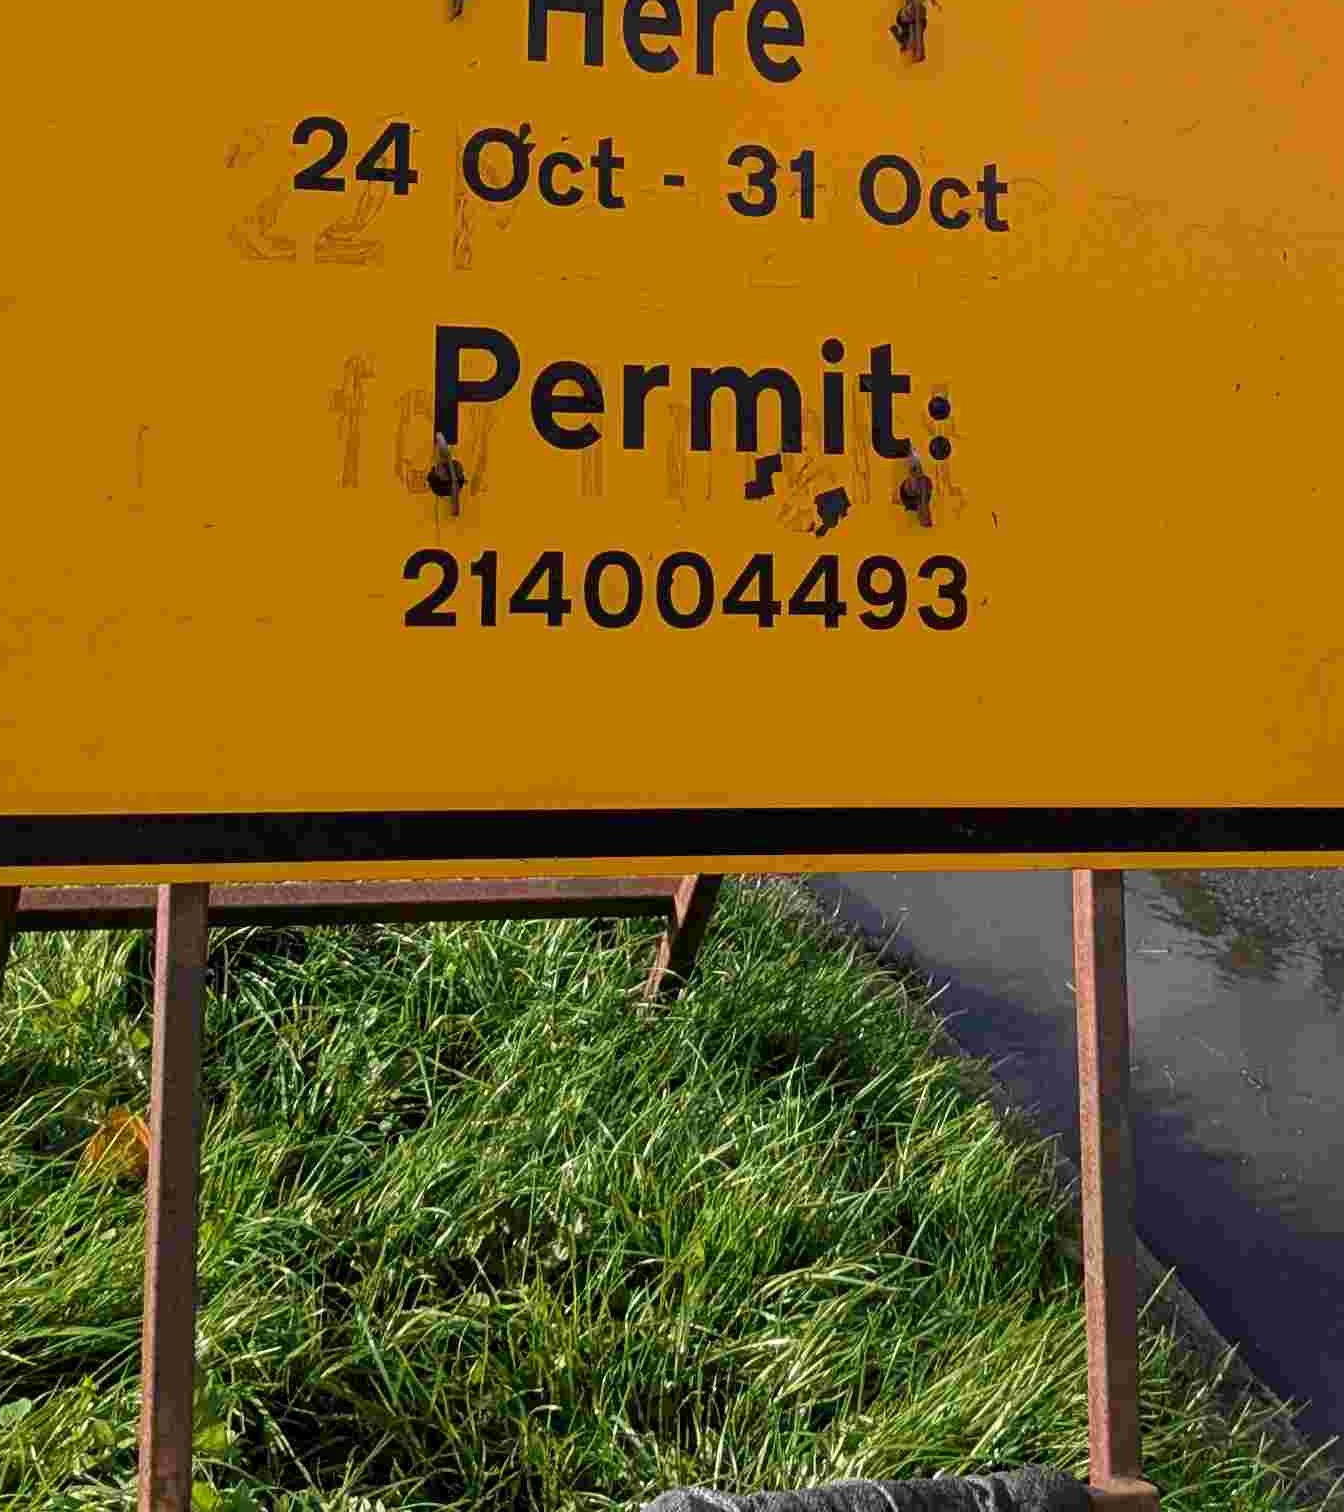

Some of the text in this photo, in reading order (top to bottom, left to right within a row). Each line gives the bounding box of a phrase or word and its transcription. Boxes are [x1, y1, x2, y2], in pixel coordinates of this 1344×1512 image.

[292, 116, 418, 196] 24
[462, 123, 625, 209] Oct
[727, 144, 815, 219] 31
[859, 154, 1009, 233] Oct
[435, 325, 951, 460] Permit:
[403, 549, 968, 631] 214004493
